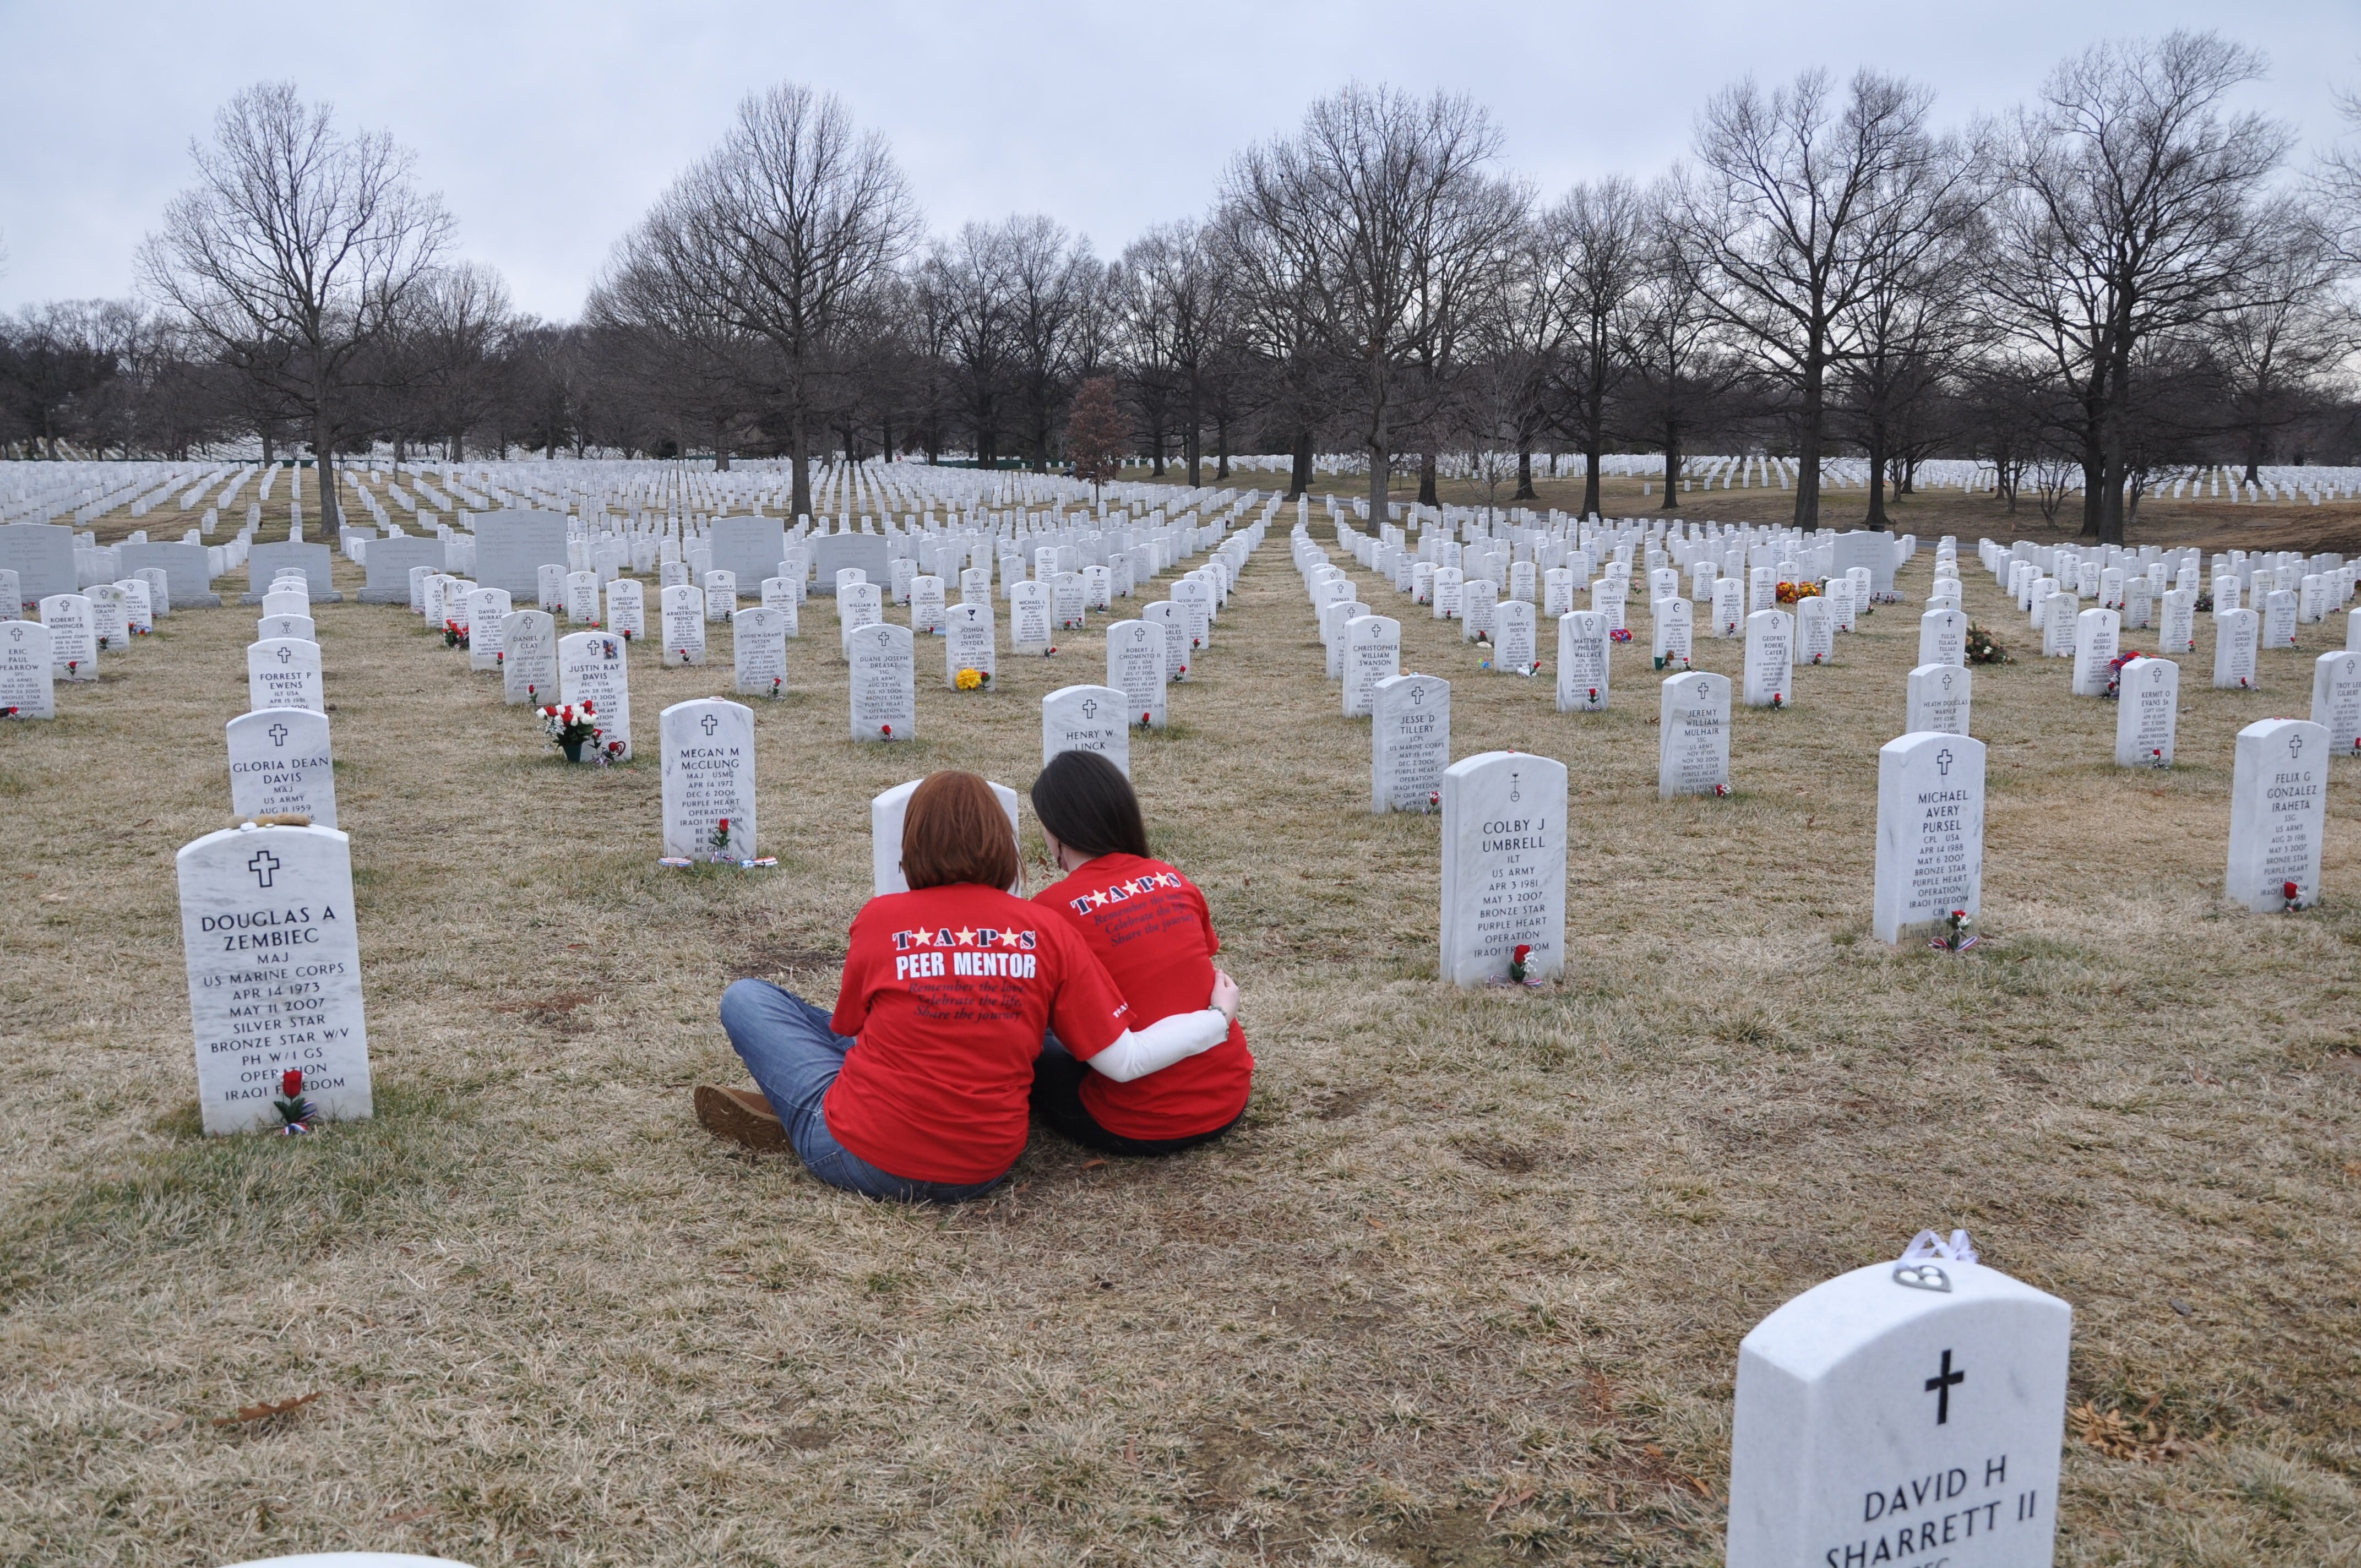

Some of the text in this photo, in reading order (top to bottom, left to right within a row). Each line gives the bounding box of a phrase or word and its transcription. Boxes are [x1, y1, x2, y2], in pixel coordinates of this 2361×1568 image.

[260, 672, 302, 680] FORREST
[270, 681, 302, 689] EWENS
[1400, 715, 1424, 724] JESSE
[1688, 709, 1717, 717] JEREMY
[1686, 718, 1718, 726] WILLIAM
[1067, 730, 1099, 740] HENRY
[1400, 725, 1434, 734] TILLERY
[1685, 727, 1719, 736] MULHAIR
[681, 748, 723, 758] MEGAN
[233, 757, 328, 772] GLORIA DEAN
[264, 772, 301, 784] DAVIS
[2276, 771, 2310, 783] FELIX G
[1918, 790, 1968, 804] MICHAEL
[2267, 785, 2316, 799] GONZALEZ
[689, 808, 735, 816] OPERATION
[1926, 805, 1960, 818] AVERY
[2272, 800, 2310, 812] IRAHETA
[1483, 818, 1544, 834] COLBY J
[1923, 820, 1961, 833] PURSEL
[1483, 836, 1545, 852] UMBRELL
[1924, 836, 1937, 844] CPL
[1947, 843, 1963, 852] 1988
[1944, 854, 1964, 863] 2007
[1492, 867, 1535, 878] US ARMY
[1914, 864, 1966, 876] BRONZE STAR
[1489, 882, 1506, 891] APR
[1521, 879, 1538, 888] 1981
[1913, 874, 1967, 887] PURPLE HEART
[1483, 896, 1502, 905] MAY
[1517, 891, 1542, 901] 2007
[1918, 886, 1961, 897] OPERATION
[1934, 895, 1968, 905] FREEDOM
[1480, 905, 1545, 918] BRONZE STAR
[1933, 908, 1945, 916] CIB
[202, 906, 335, 935] DOUGLAS A
[1478, 917, 1547, 931] PURPLE HEART
[224, 928, 319, 951] ZEMBIEC
[1485, 930, 1539, 944] OPERATION
[1475, 943, 1549, 957] IRAQI FRDOM
[258, 952, 288, 964] MAJ
[896, 951, 1036, 981] PEER MENTOR
[204, 962, 344, 987] US MARINE CORPS
[233, 982, 319, 1000] APR 14 1973
[979, 981, 997, 991] the
[978, 995, 997, 1005] the
[230, 998, 325, 1017] MAY 11 2007
[955, 1006, 973, 1019] the
[233, 1015, 325, 1034] SILVER STAR
[211, 1028, 349, 1053] BRONZE STAR W/V
[242, 1054, 260, 1066] PH
[304, 1047, 322, 1058] GS
[226, 1077, 345, 1101] IRAQI FEDOM
[1864, 1455, 2006, 1527] DAVID H
[1826, 1490, 2035, 1568] SHARRETT II
